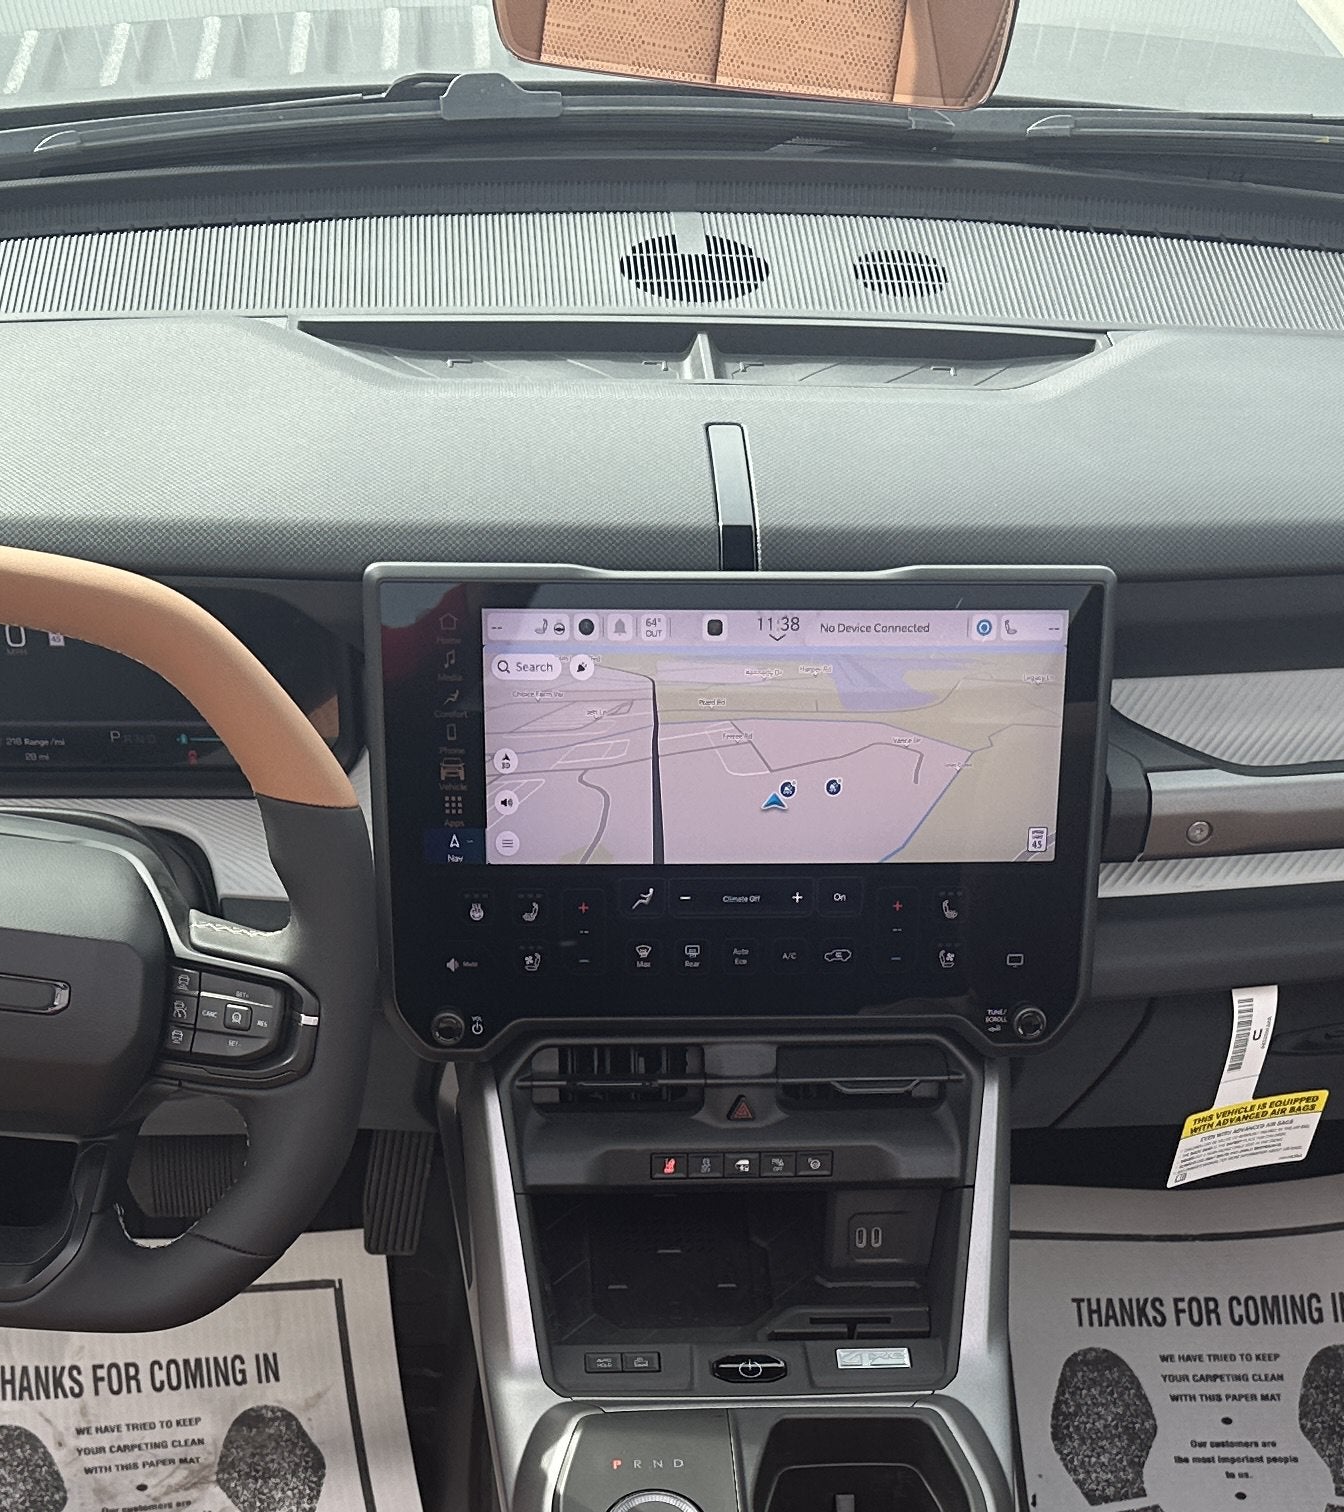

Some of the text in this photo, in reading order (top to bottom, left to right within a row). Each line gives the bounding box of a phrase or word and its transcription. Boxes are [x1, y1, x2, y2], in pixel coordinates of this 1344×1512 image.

[757, 616, 800, 631] 11:38
[820, 623, 930, 633] No Device Connected
[515, 661, 554, 673] Search
[110, 730, 120, 743] P
[23, 737, 50, 748] Range
[438, 783, 468, 791] Vehicle
[443, 818, 465, 828] Apps
[447, 854, 464, 863] Nav
[833, 893, 846, 902] On
[782, 951, 797, 961] A/C
[1192, 1095, 1320, 1126] THIS VEHICLE IS EQUIPPED
[1190, 1103, 1317, 1135] WITH ADVANCED AIR BAGS
[1071, 1297, 1167, 1328] THANKS
[1172, 1296, 1222, 1327] FOR
[1228, 1292, 1324, 1326] COMING
[1159, 1352, 1281, 1363] WE HAVE TRIED TO KEEP
[92, 1361, 142, 1396] FOR
[149, 1354, 248, 1393] COMING
[254, 1352, 281, 1384] IN
[1161, 1373, 1285, 1383] YOUR CARPETING CLEAN
[1169, 1393, 1282, 1402] WITH THIS PAPER MAT
[75, 1416, 202, 1436] WE HAVE TRIED TO KEEP
[76, 1437, 205, 1456] YOUR CARPETING CLEAN
[1190, 1439, 1208, 1448] Our
[1209, 1440, 1259, 1448] customers
[83, 1456, 201, 1475] WITH THIS PAPER MAT
[613, 1458, 684, 1470] P R N D
[1191, 1455, 1216, 1464] most
[1217, 1455, 1265, 1465] important
[1266, 1455, 1299, 1465] people
[1225, 1470, 1236, 1479] to
[175, 1500, 192, 1508] are
